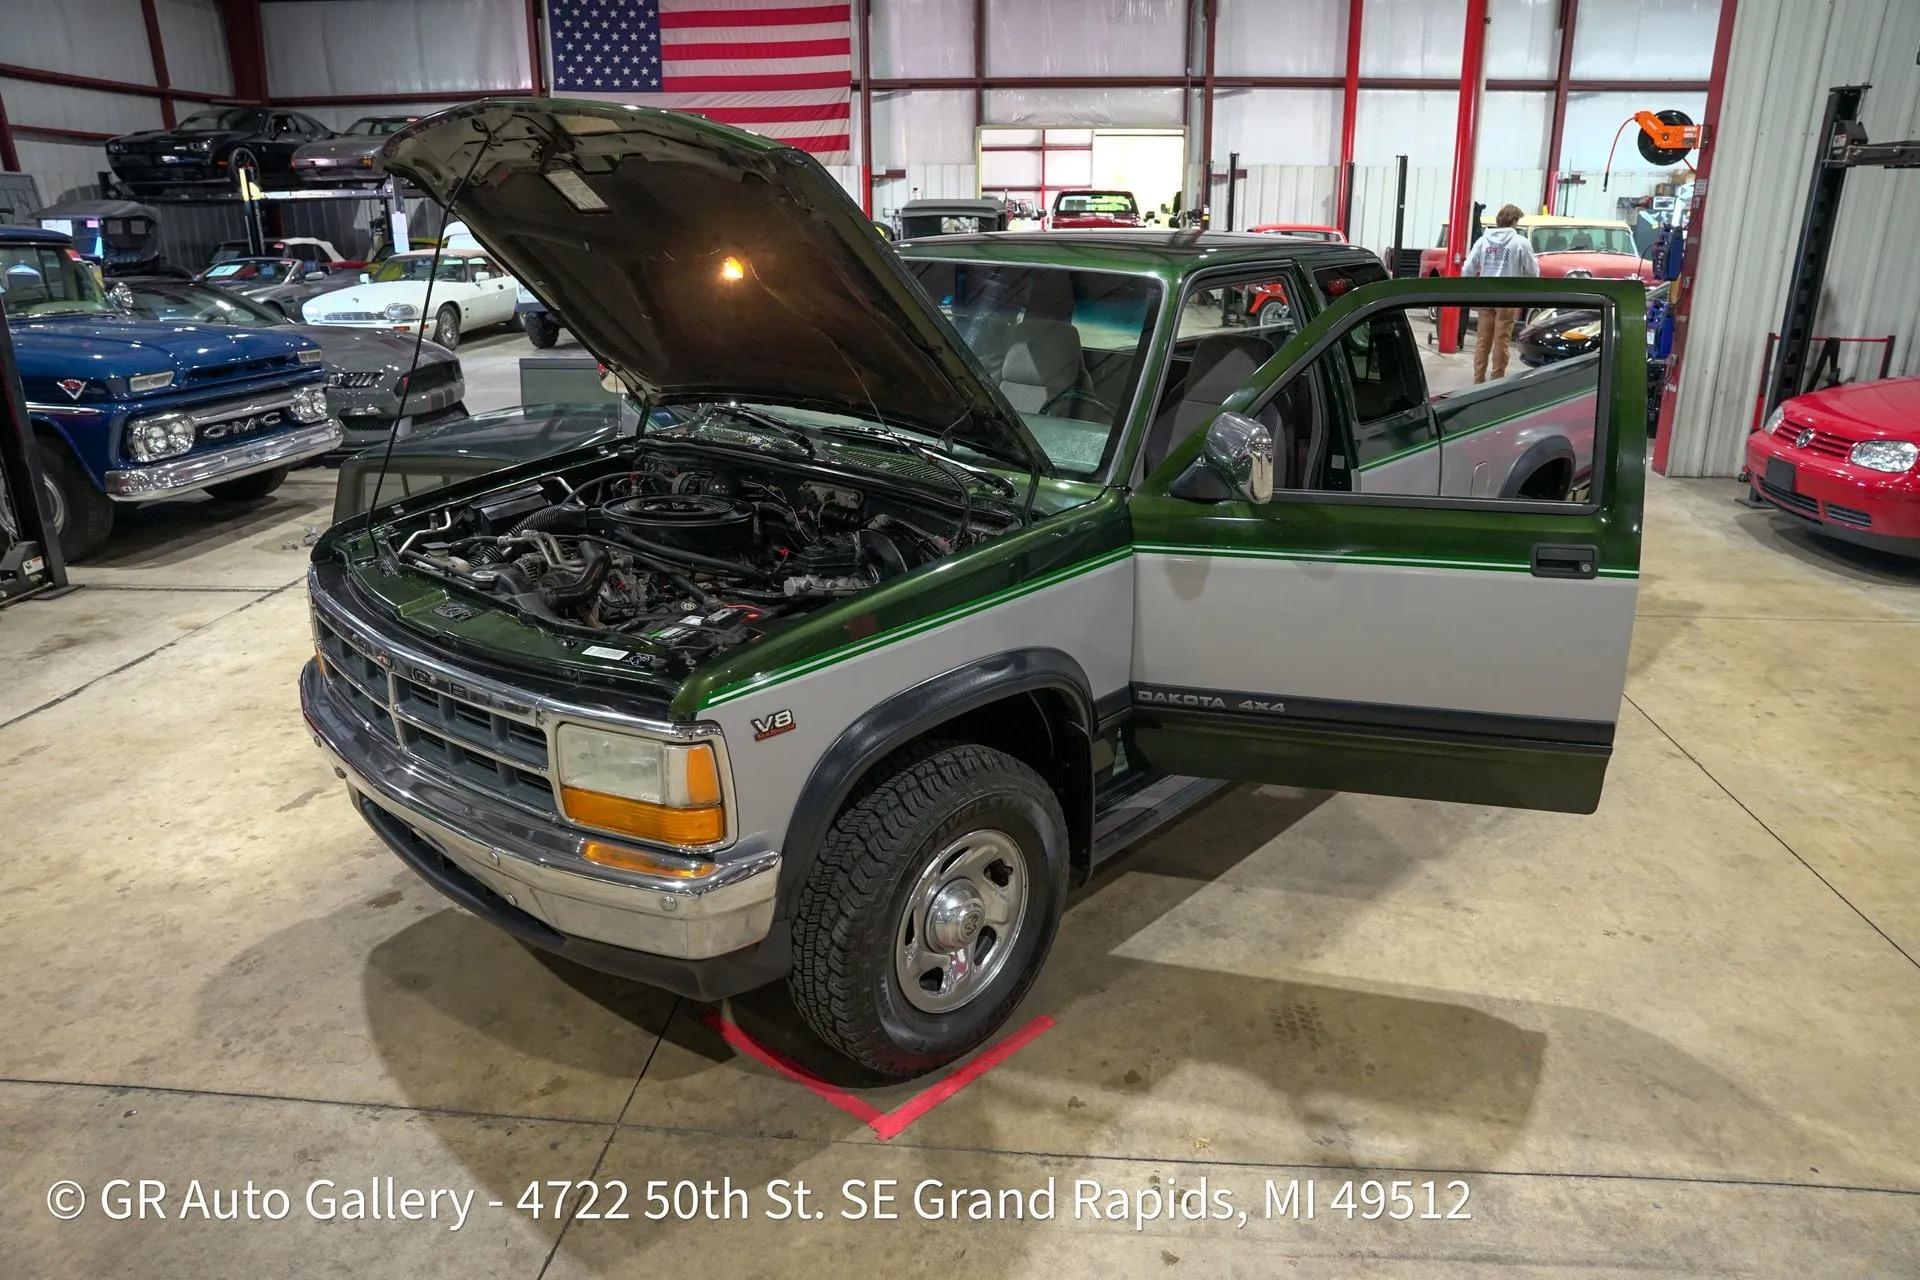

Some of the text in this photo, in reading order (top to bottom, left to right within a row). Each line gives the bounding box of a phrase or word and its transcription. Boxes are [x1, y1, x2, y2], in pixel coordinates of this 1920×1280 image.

[203, 412, 281, 439] GMC
[1136, 690, 1227, 709] DAKOTA
[750, 708, 794, 733] V8
